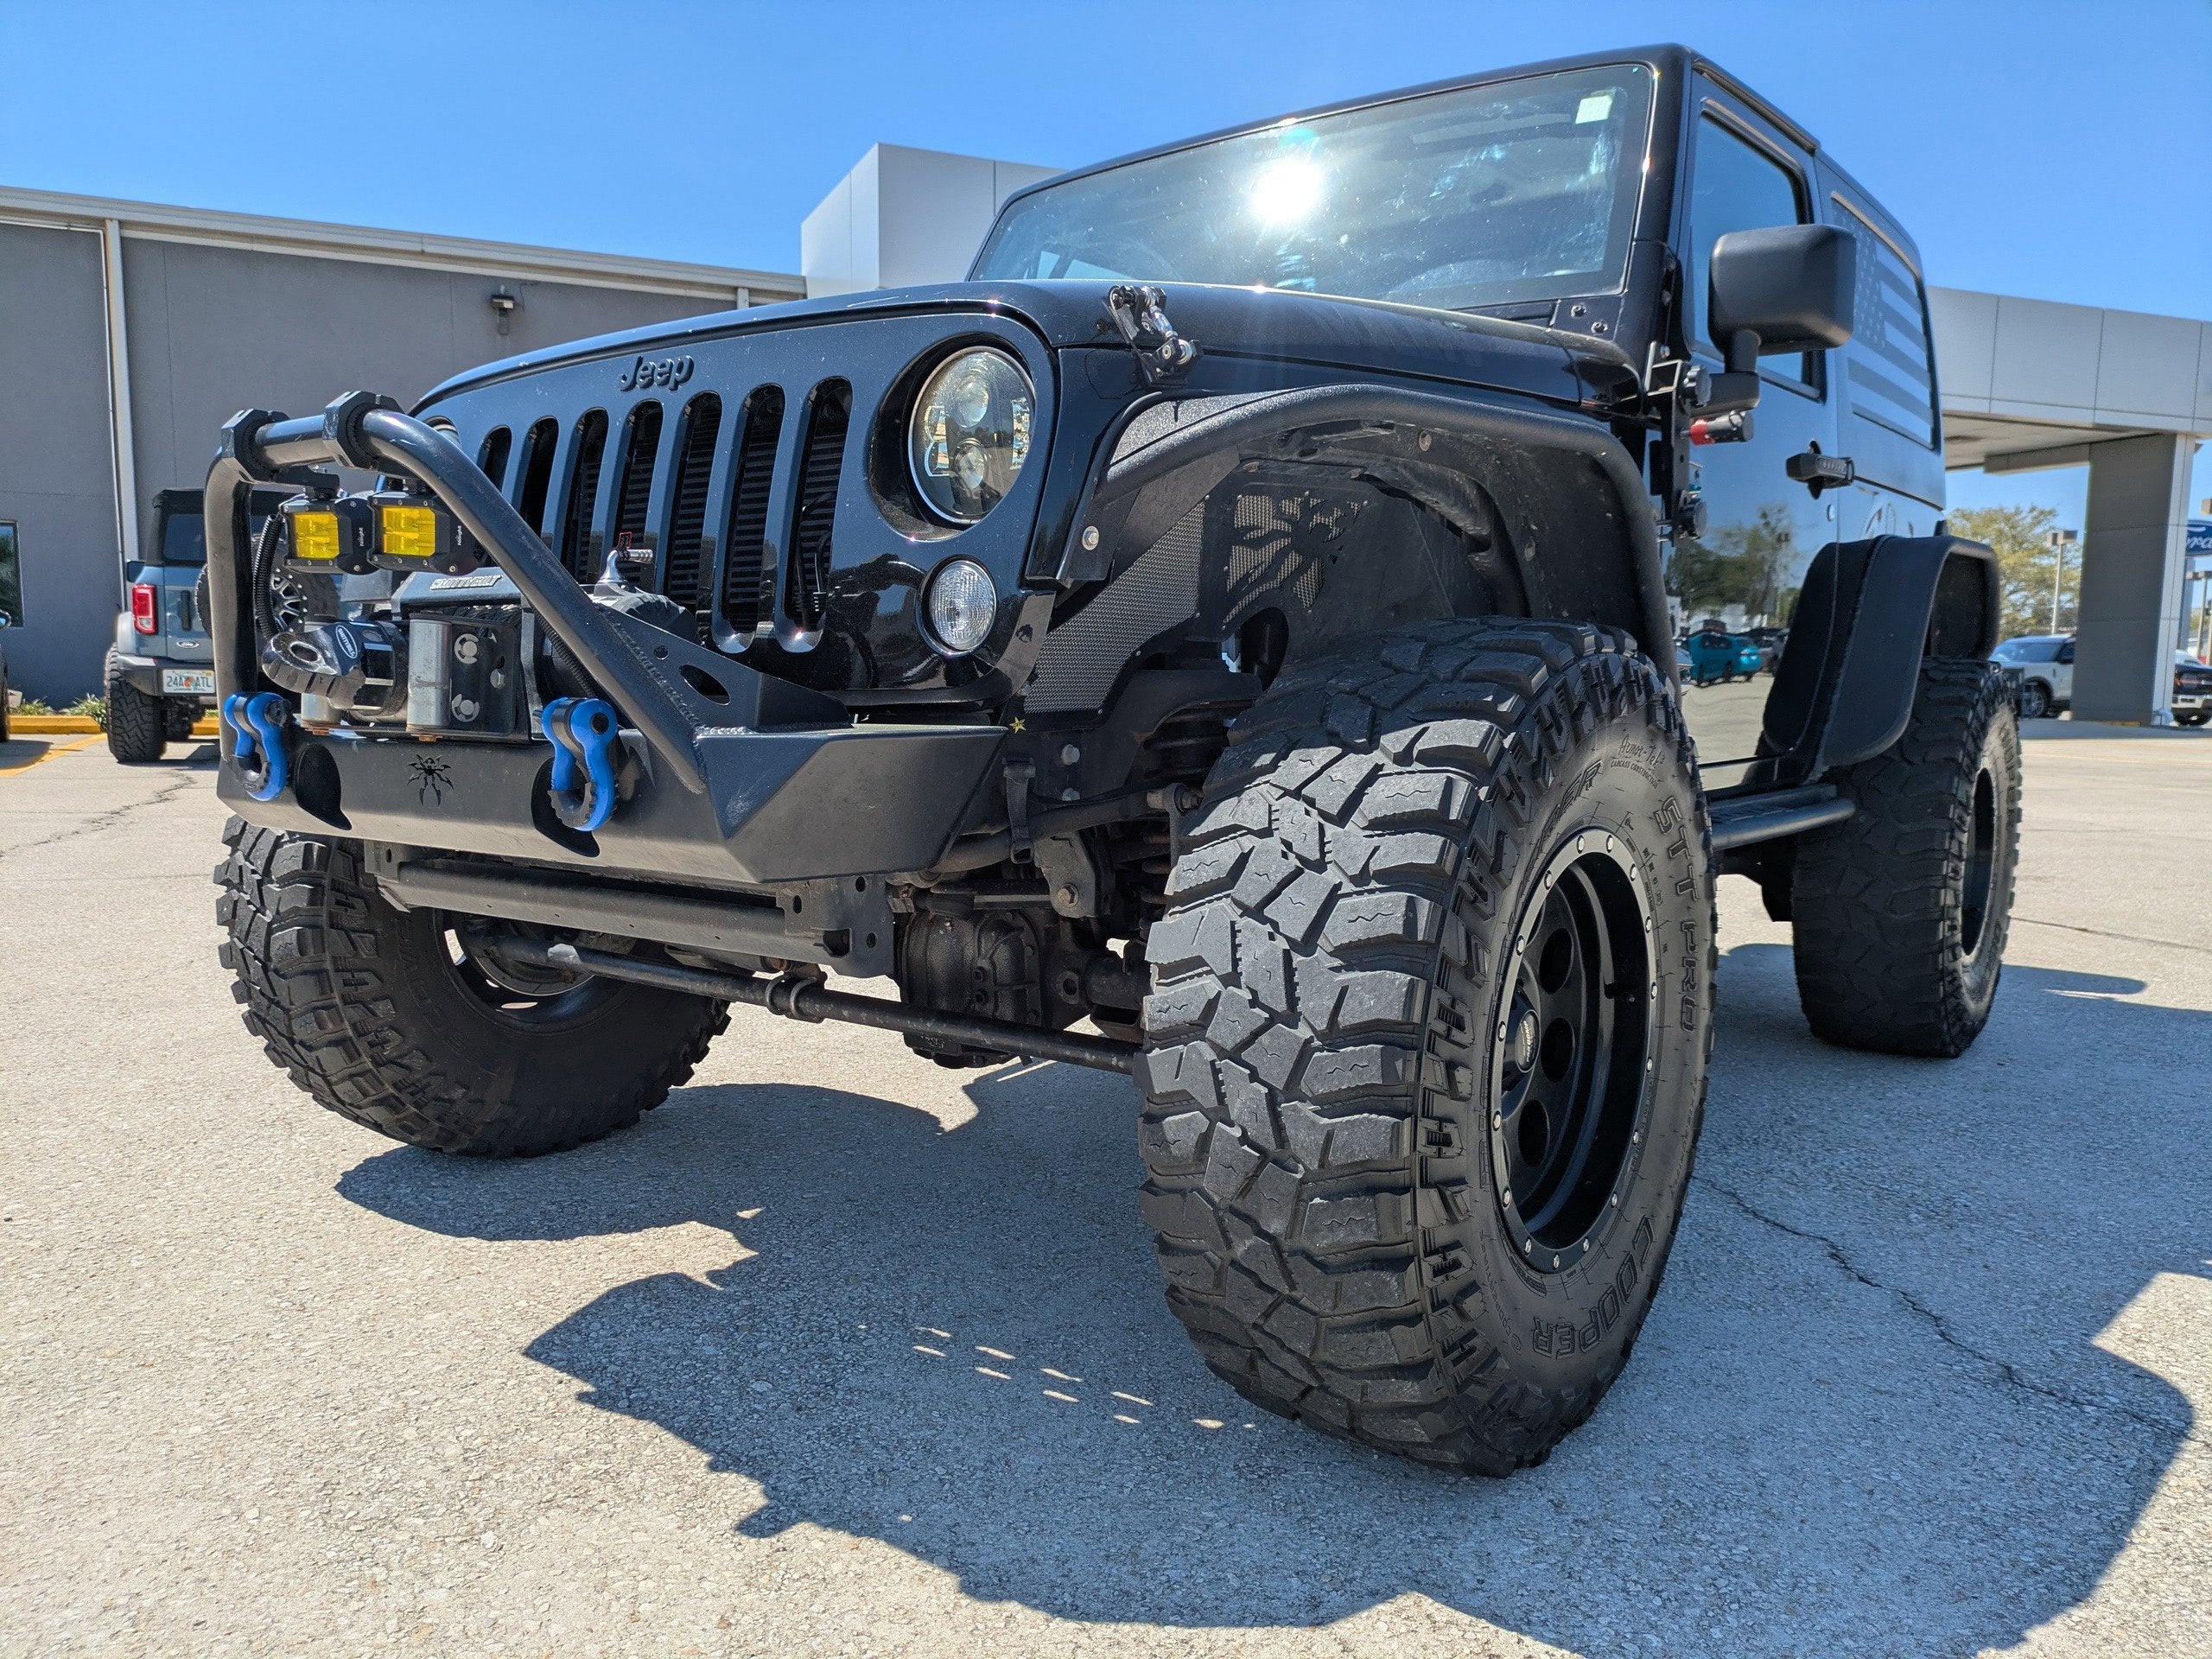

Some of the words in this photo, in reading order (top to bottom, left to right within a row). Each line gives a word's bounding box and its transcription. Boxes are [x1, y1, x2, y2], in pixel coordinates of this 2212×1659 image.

[620, 355, 695, 391] Jeep
[1653, 796, 1700, 902] STT
[1680, 919, 1697, 1033] PRO
[1533, 1214, 1656, 1360] COOPER
